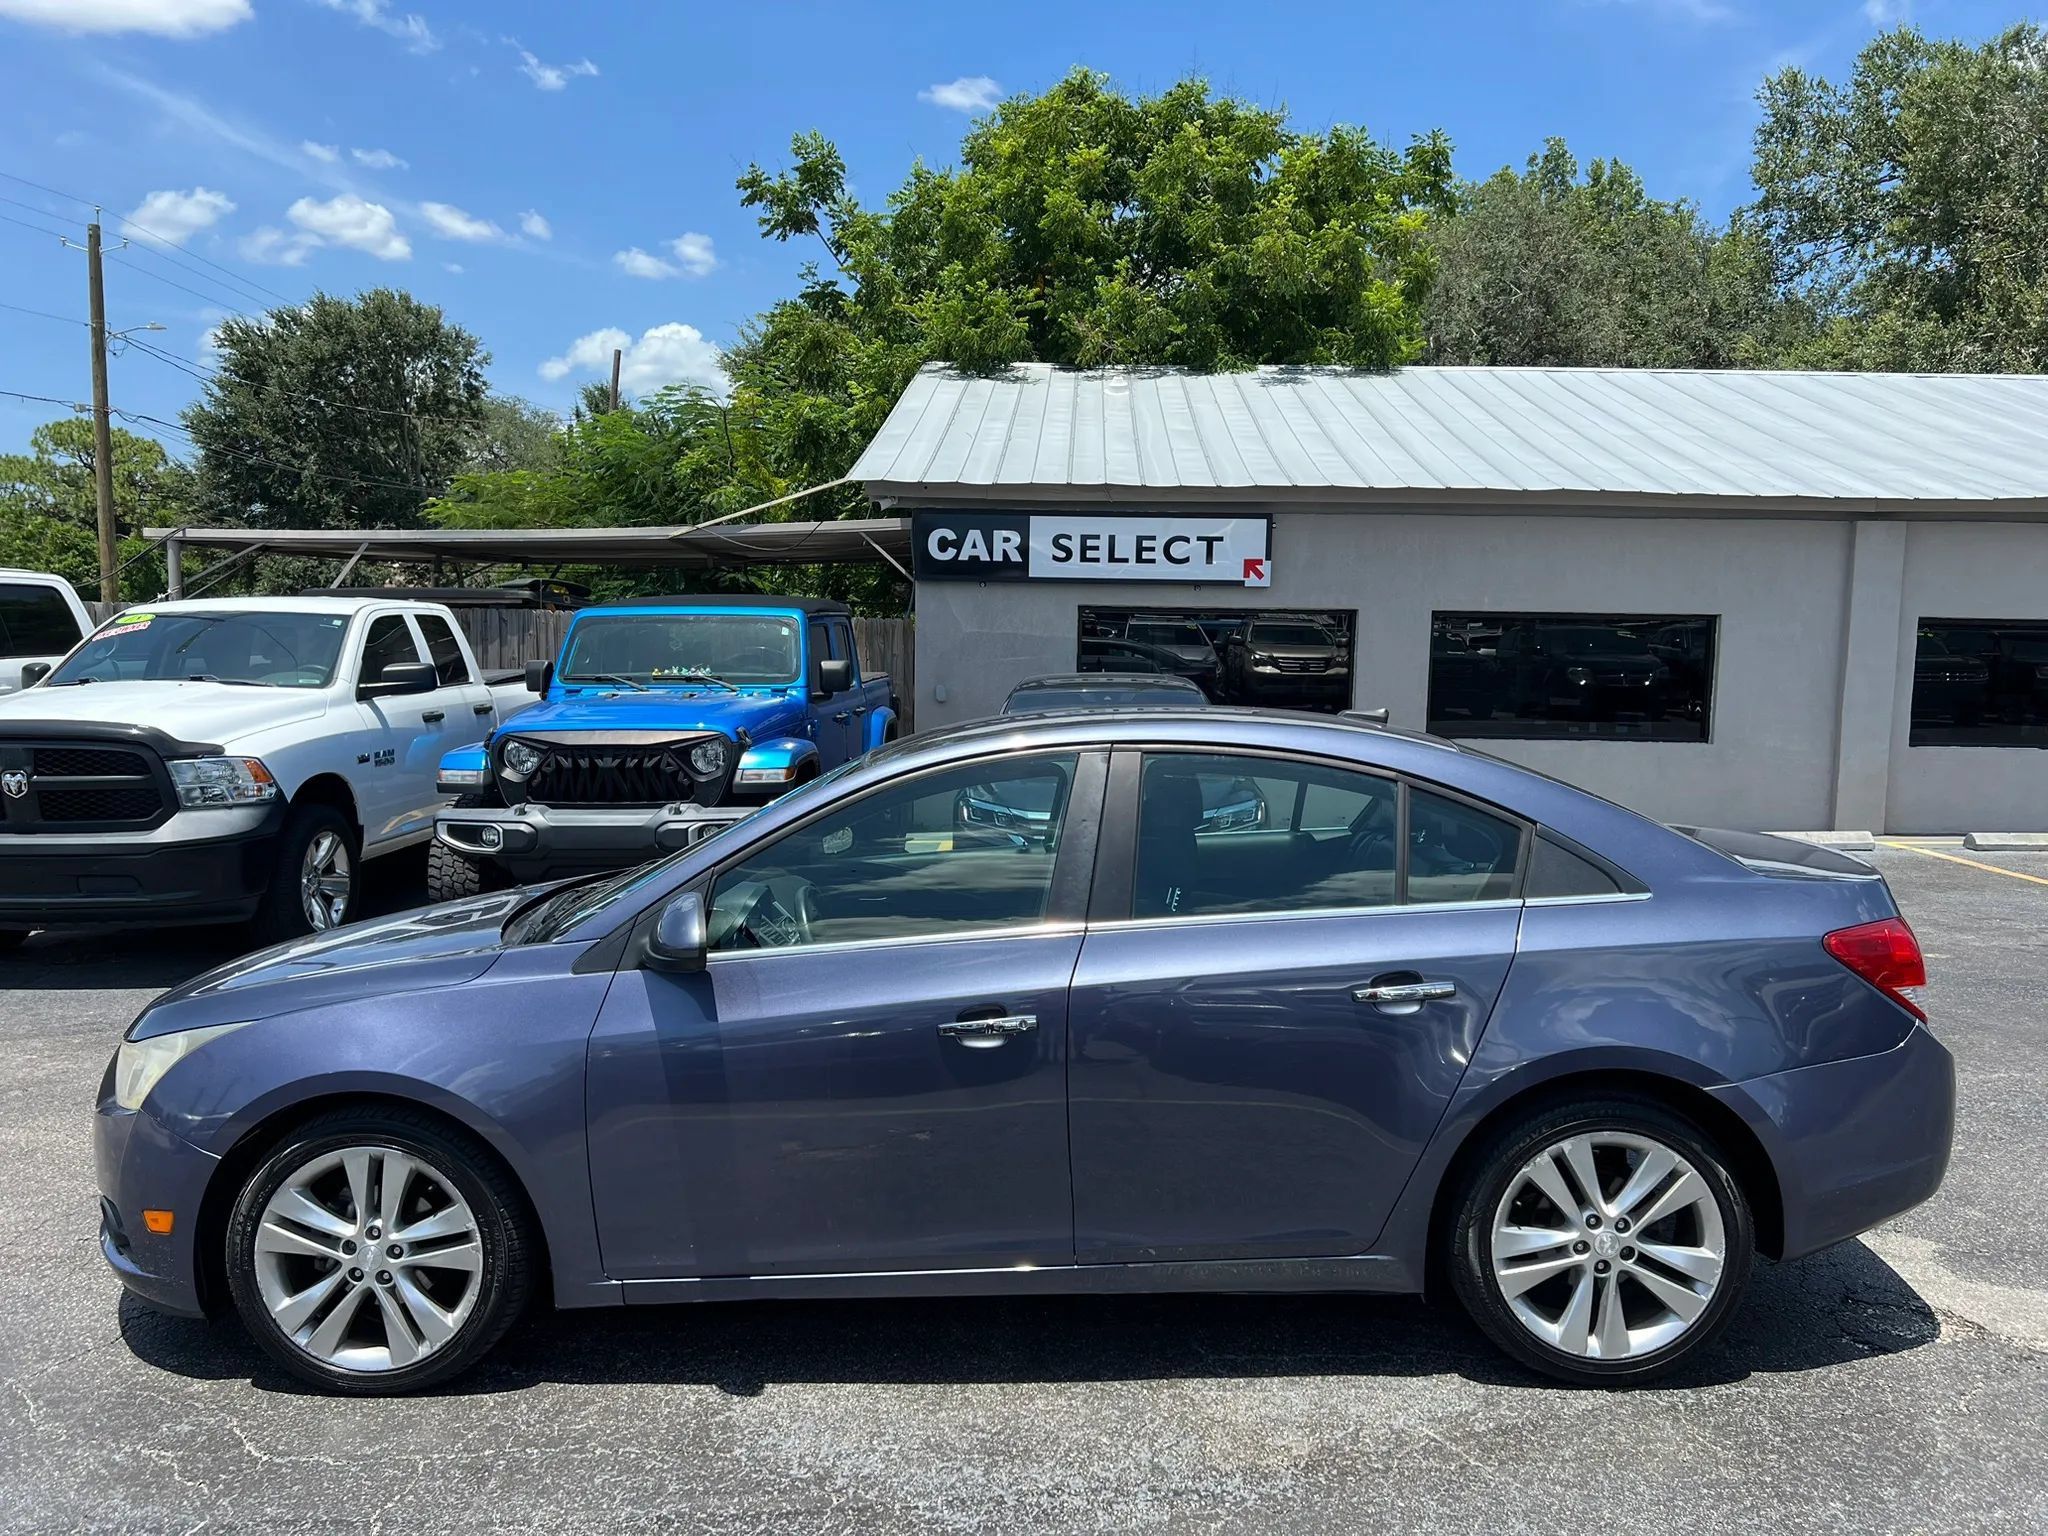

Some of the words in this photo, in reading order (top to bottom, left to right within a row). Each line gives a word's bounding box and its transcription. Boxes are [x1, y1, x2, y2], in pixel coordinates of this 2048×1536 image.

[927, 528, 1023, 562] CAR
[1051, 534, 1224, 565] SELECT
[374, 749, 395, 760] RAM
